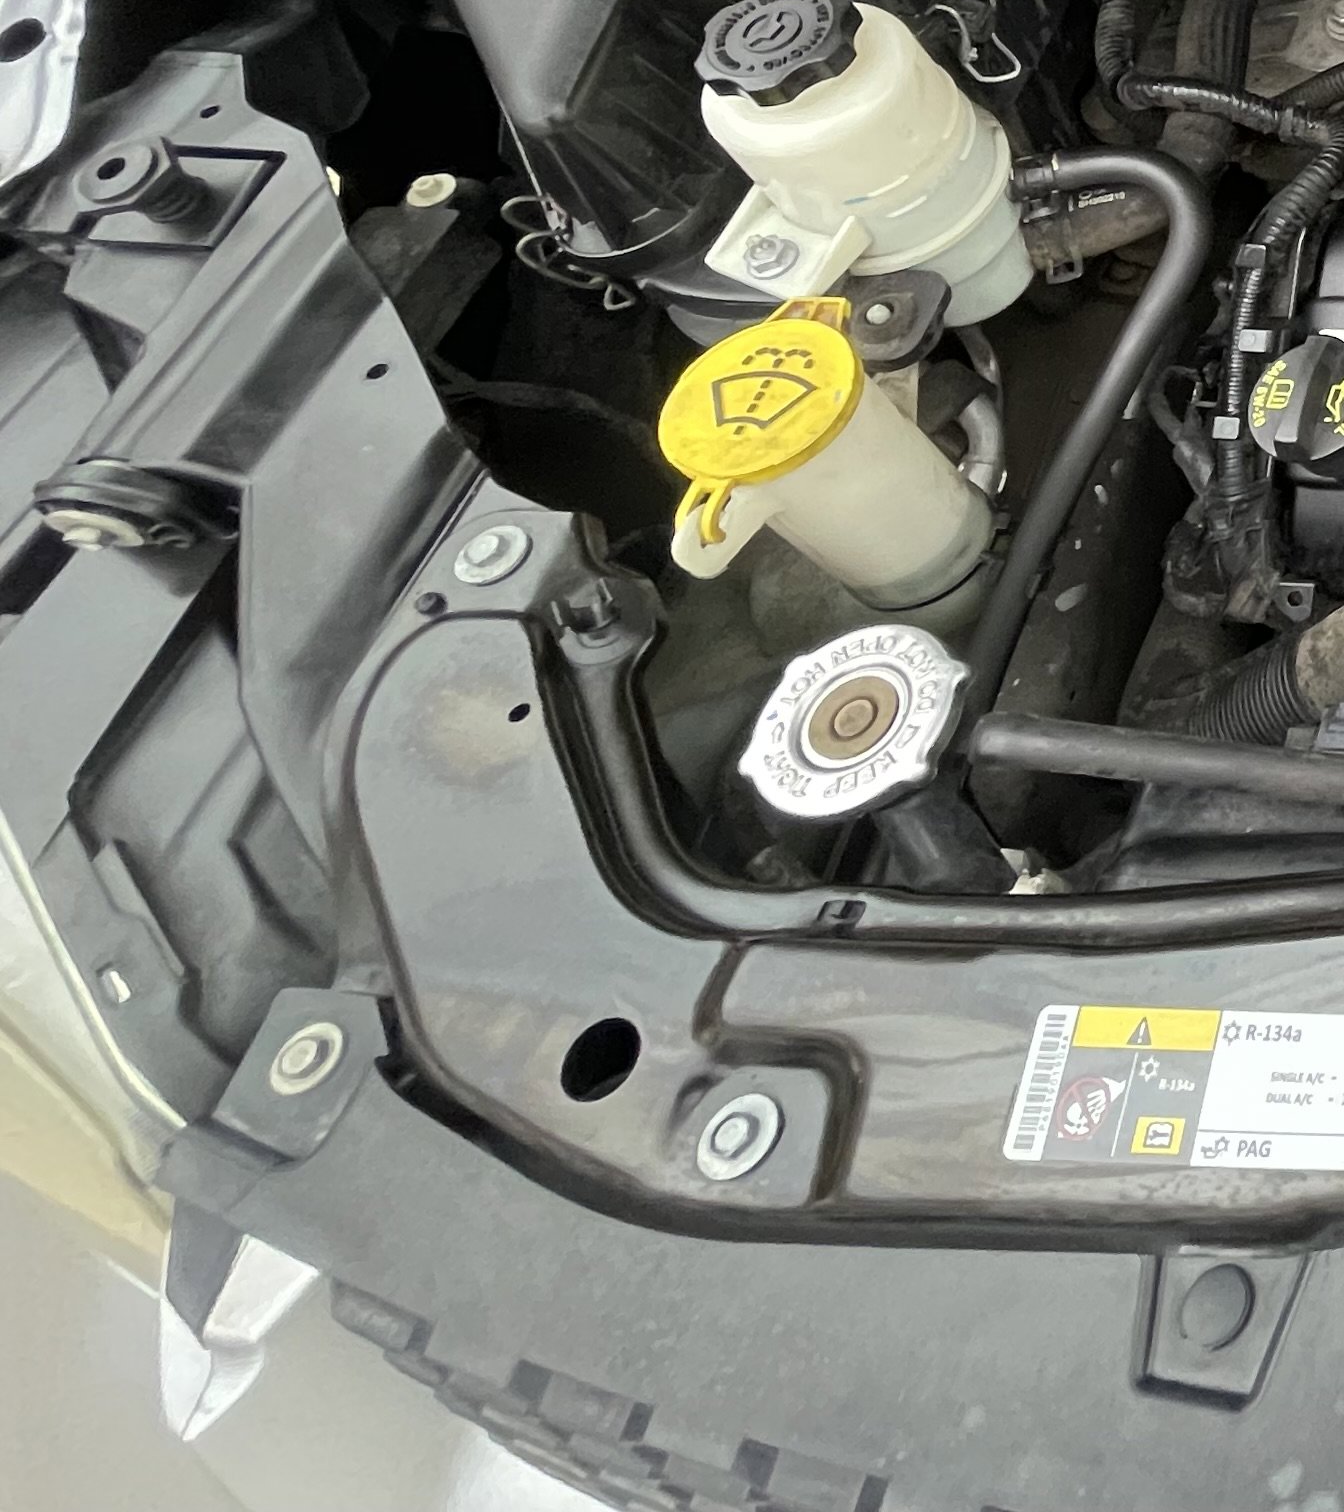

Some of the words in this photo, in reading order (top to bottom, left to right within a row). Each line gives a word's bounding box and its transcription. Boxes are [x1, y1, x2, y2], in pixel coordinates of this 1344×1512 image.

[1262, 360, 1287, 385] SAE
[830, 635, 899, 668] OPEN
[781, 661, 826, 706] HOT
[823, 750, 897, 799] KEEP
[1244, 1023, 1303, 1044] R-134a
[1306, 1072, 1326, 1085] A/C
[1265, 1092, 1293, 1105] DUAL
[1294, 1093, 1314, 1106] A/C
[1236, 1140, 1273, 1159] PAG
